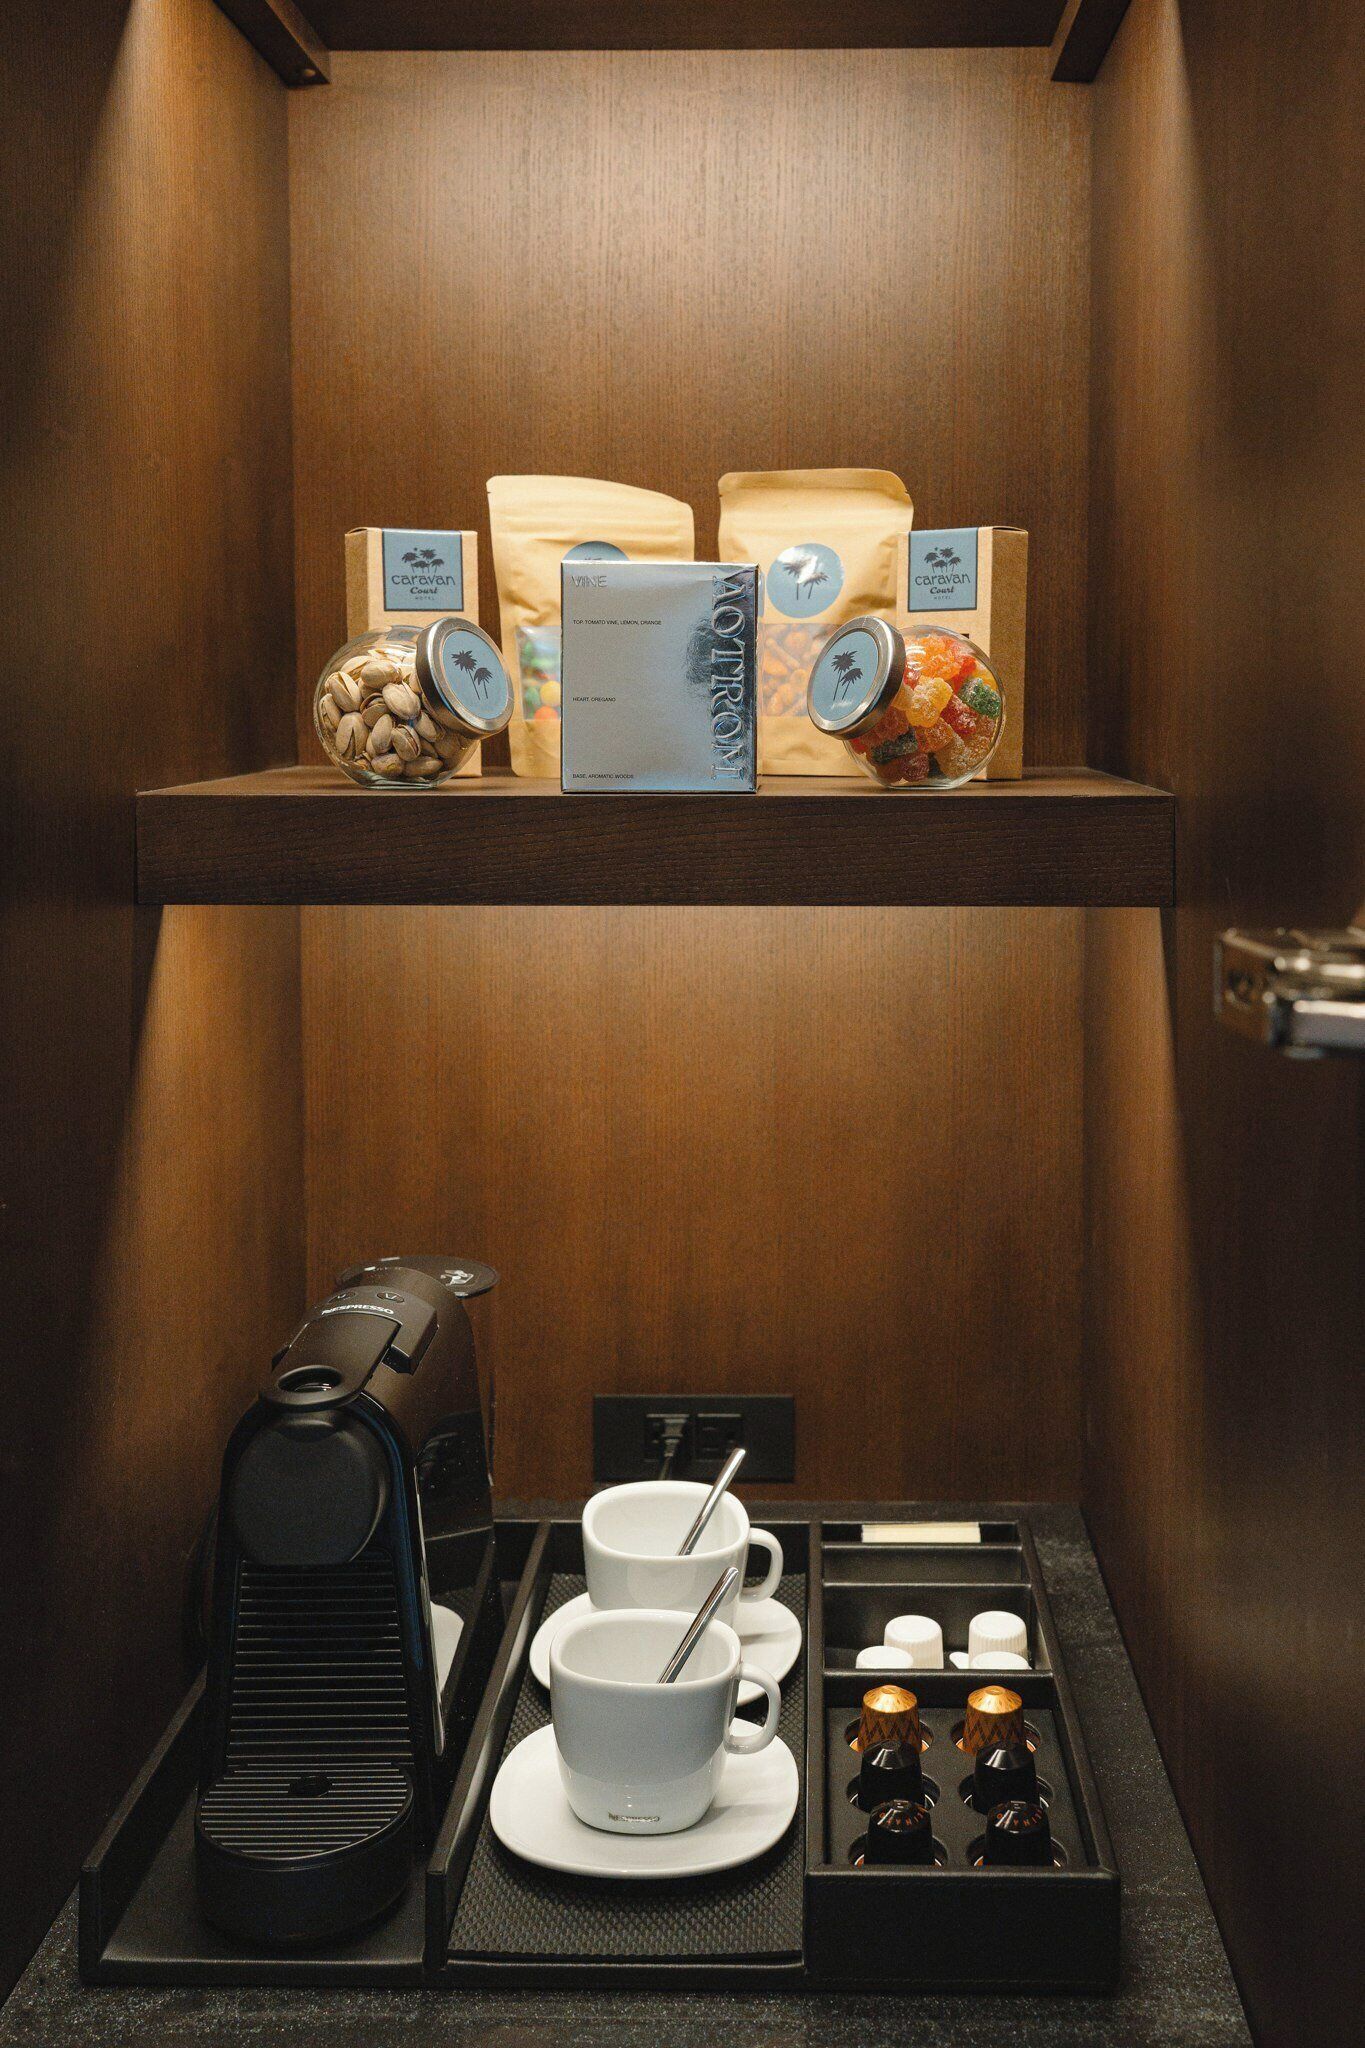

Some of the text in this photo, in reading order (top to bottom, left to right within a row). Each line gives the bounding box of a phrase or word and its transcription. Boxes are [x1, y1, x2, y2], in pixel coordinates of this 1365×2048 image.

[391, 573, 456, 586] caravan
[571, 575, 607, 588] VINE
[915, 572, 971, 586] caravan
[410, 586, 439, 595] Court
[930, 585, 954, 595] Court
